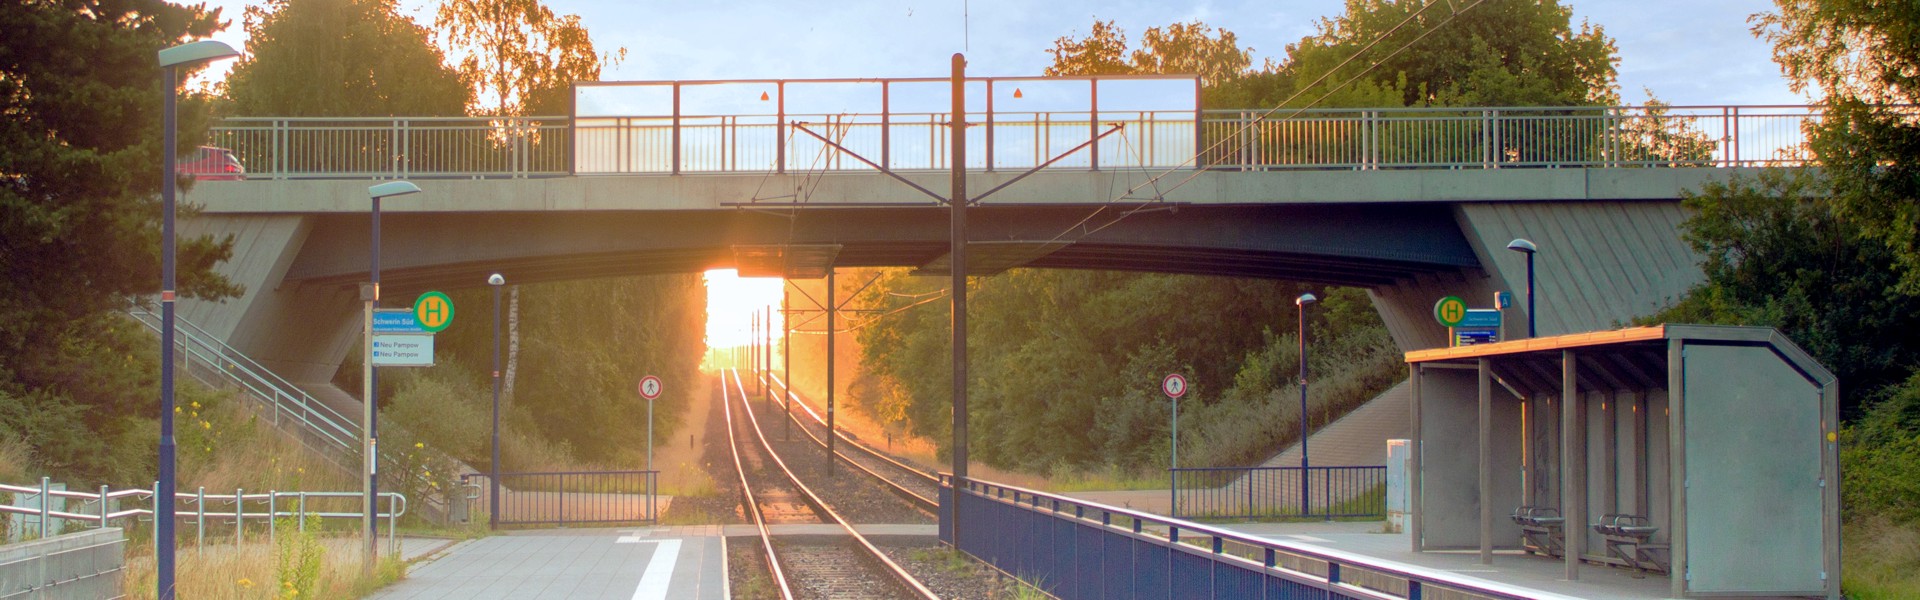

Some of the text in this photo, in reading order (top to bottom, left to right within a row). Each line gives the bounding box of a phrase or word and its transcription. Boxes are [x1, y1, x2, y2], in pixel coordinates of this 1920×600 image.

[1502, 297, 1508, 306] A
[426, 301, 442, 323] H
[1447, 303, 1459, 319] H
[402, 318, 414, 326] Süd
